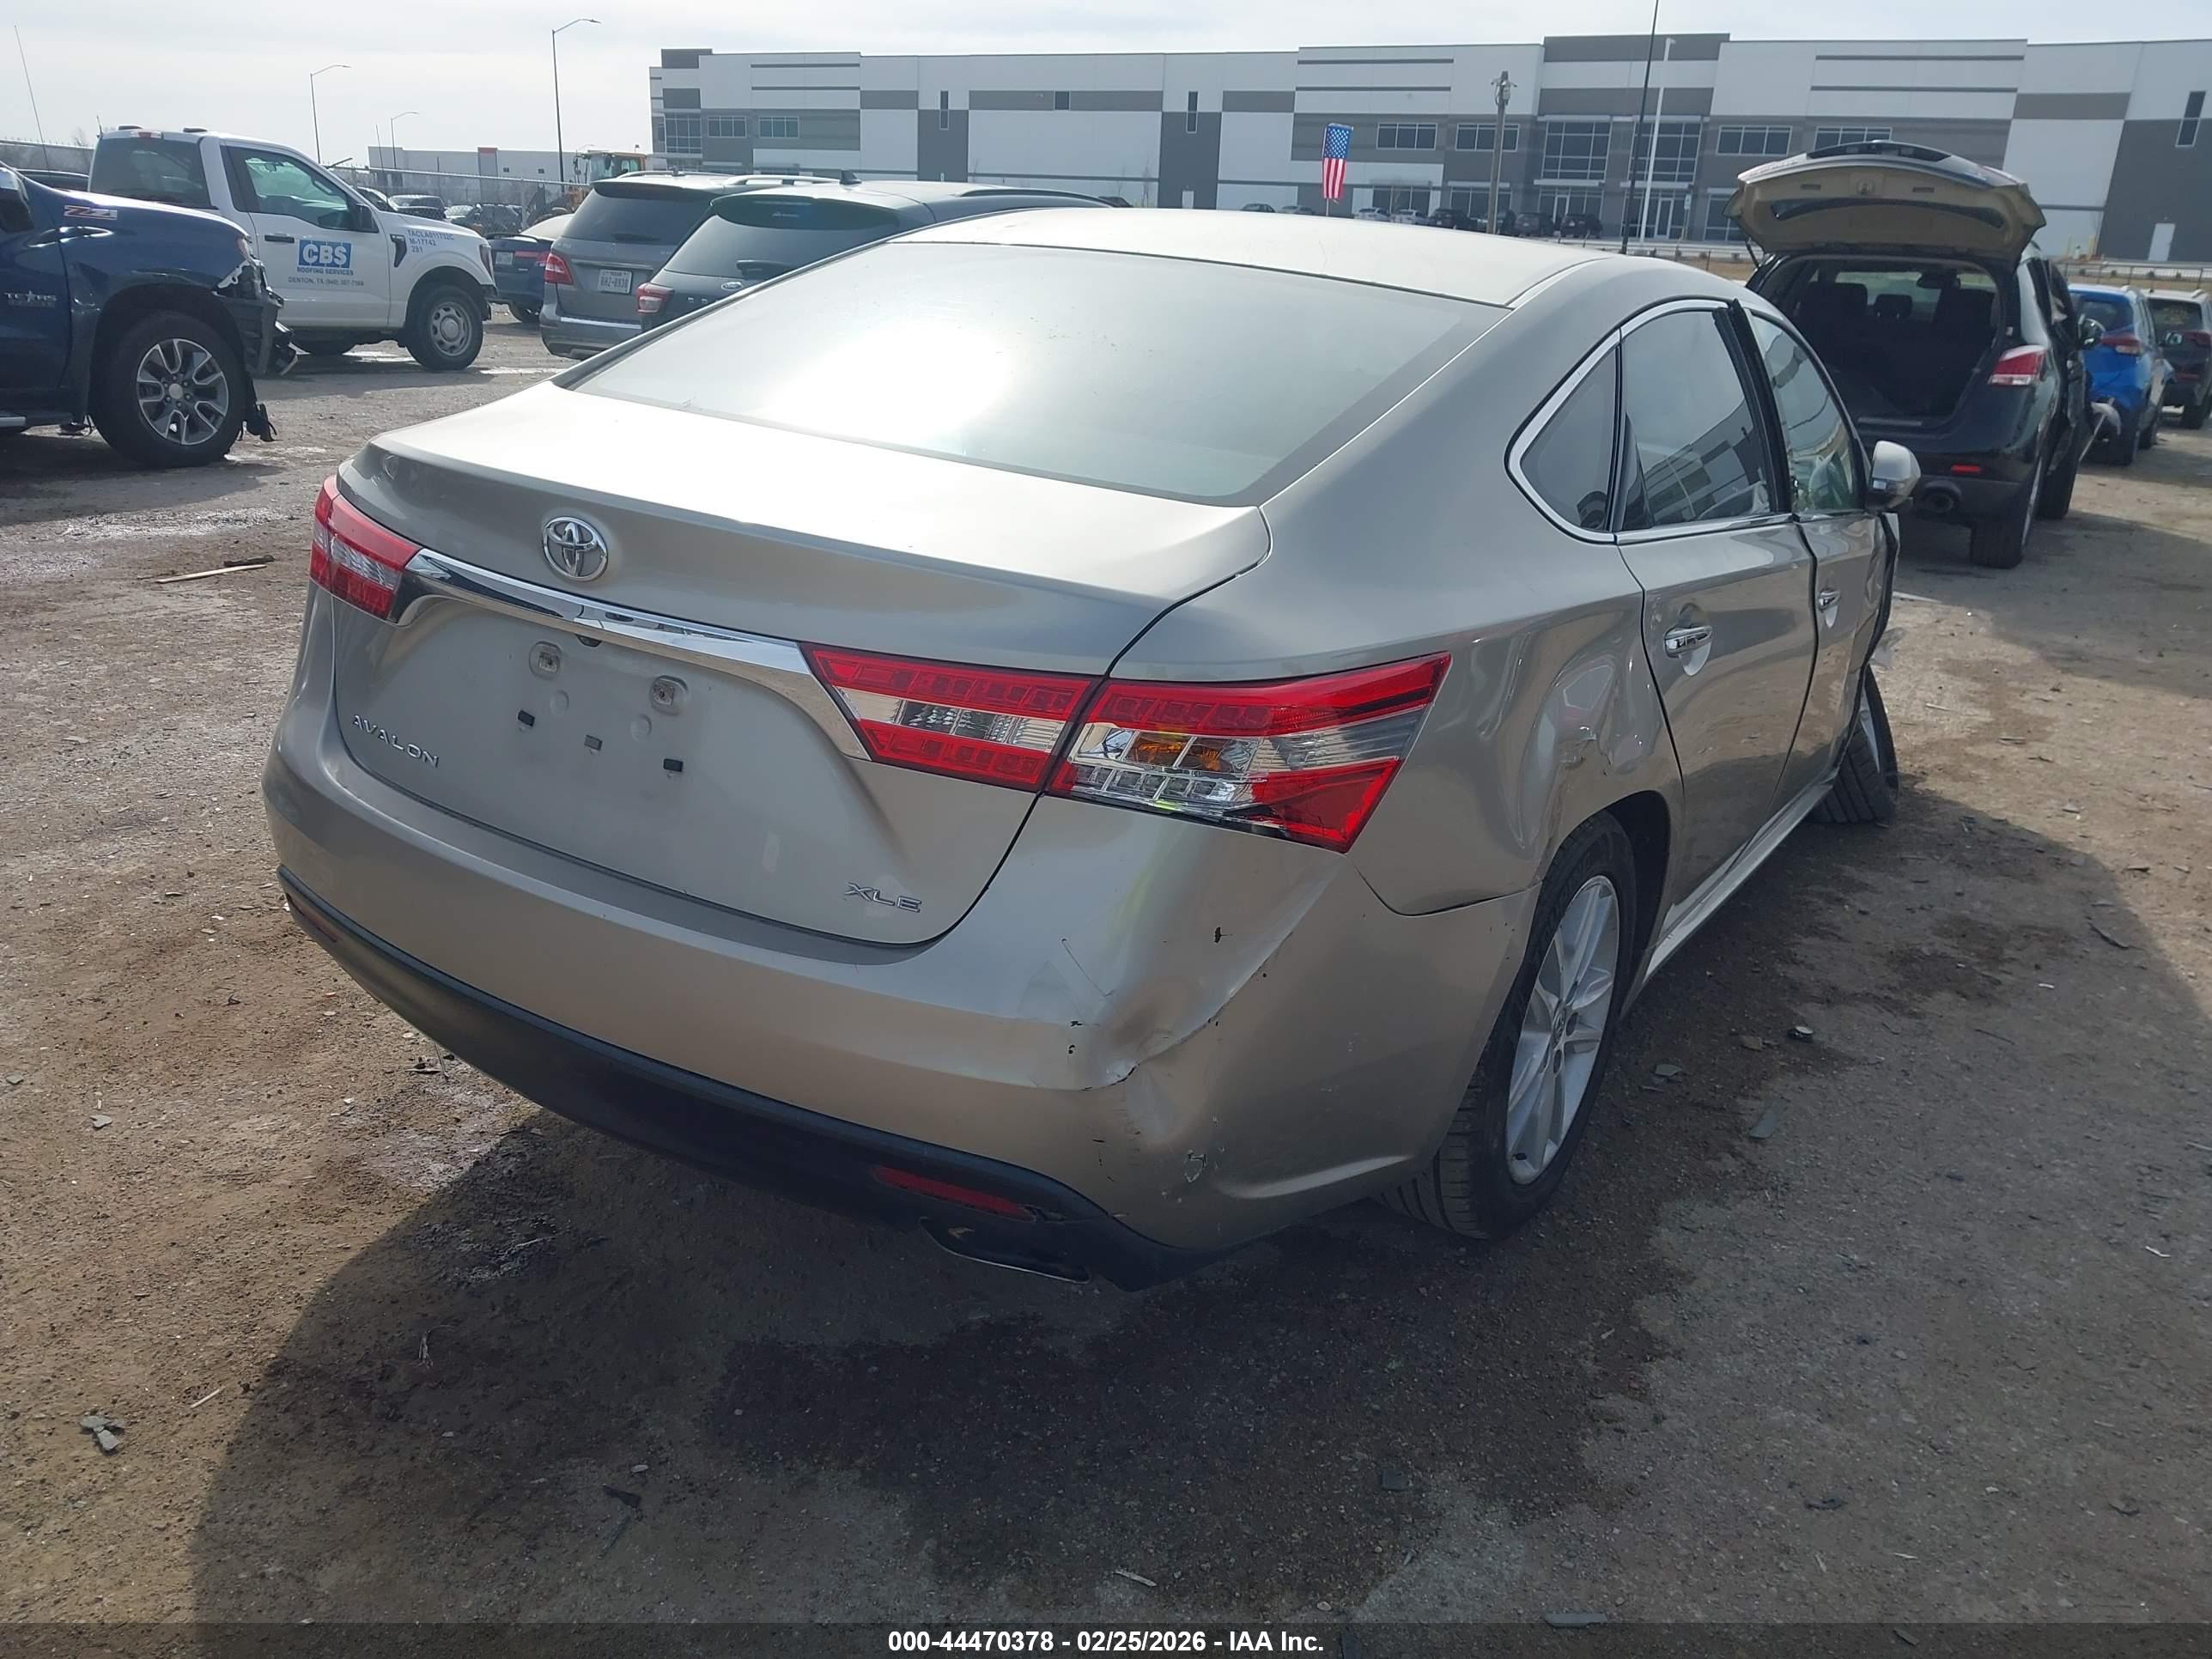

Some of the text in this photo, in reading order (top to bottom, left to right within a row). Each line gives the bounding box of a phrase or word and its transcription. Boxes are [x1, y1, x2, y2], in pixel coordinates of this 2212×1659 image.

[303, 243, 347, 265] CBS
[325, 267, 354, 276] SERVICES
[353, 714, 439, 768] AVALON
[845, 881, 922, 913] XLE
